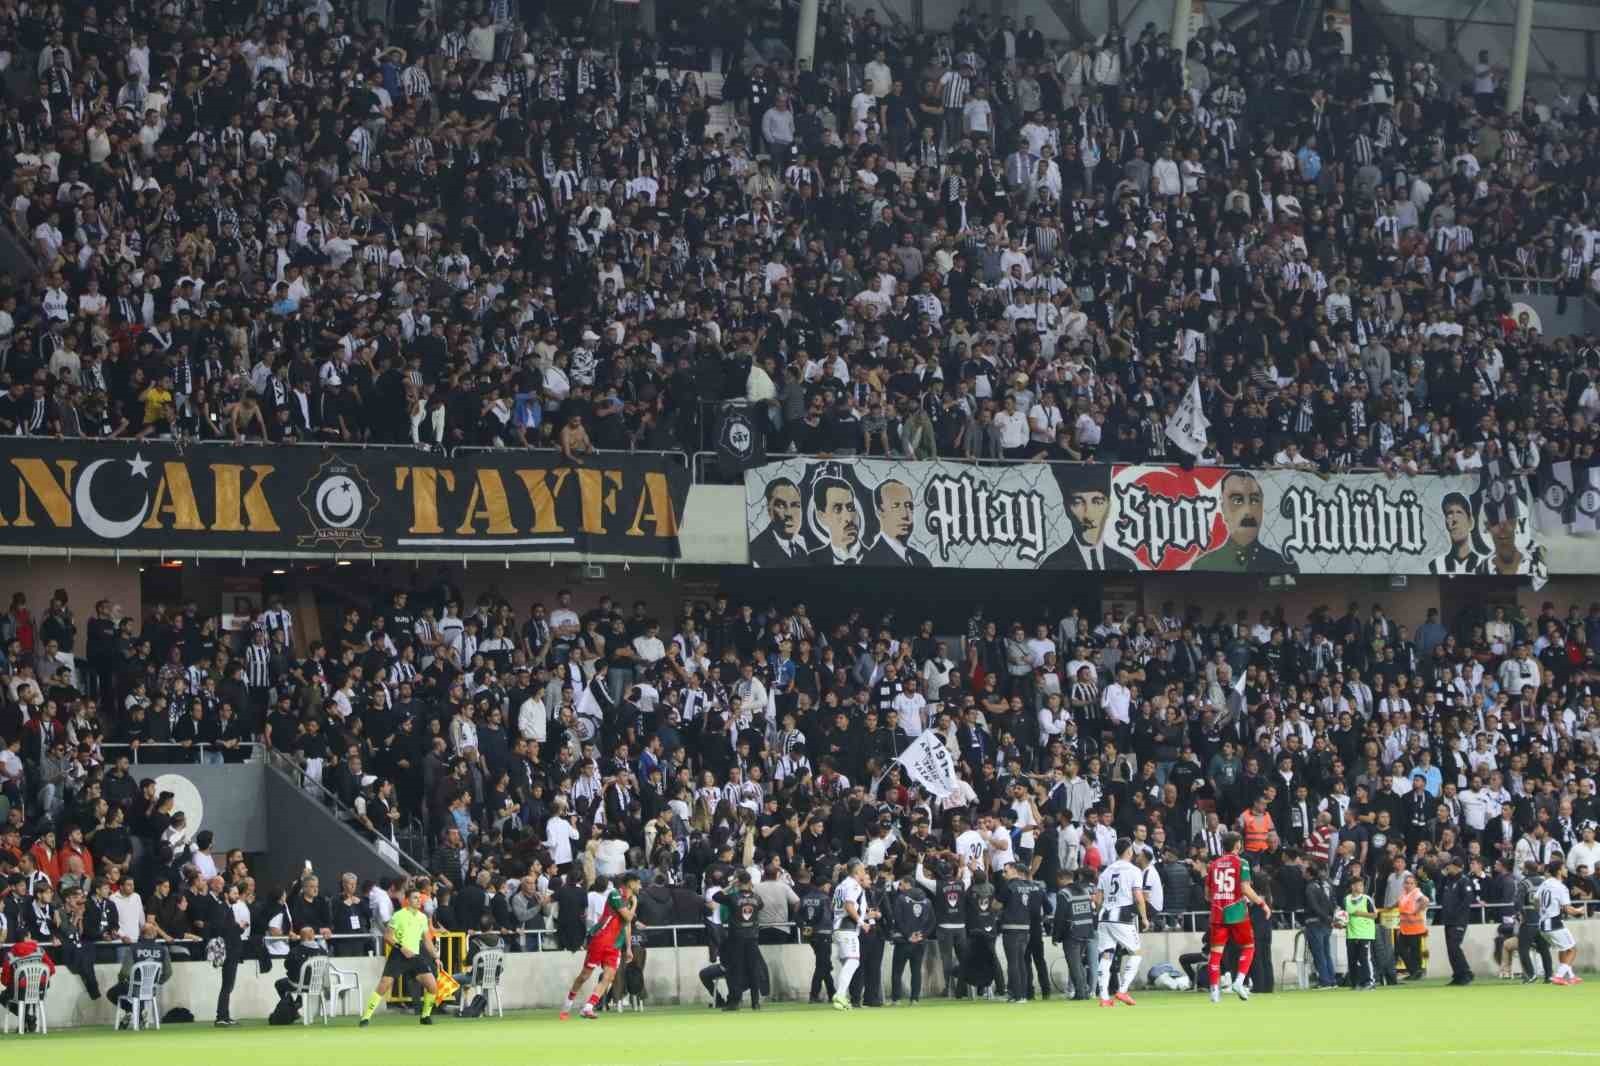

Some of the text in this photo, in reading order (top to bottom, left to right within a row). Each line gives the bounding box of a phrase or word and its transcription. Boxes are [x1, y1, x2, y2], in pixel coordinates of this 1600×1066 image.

[0, 458, 678, 538] NCAK TAYFA
[925, 473, 1427, 567] Altay Spor Kulübü
[1109, 873, 1120, 895] 5
[1214, 868, 1235, 893] 45
